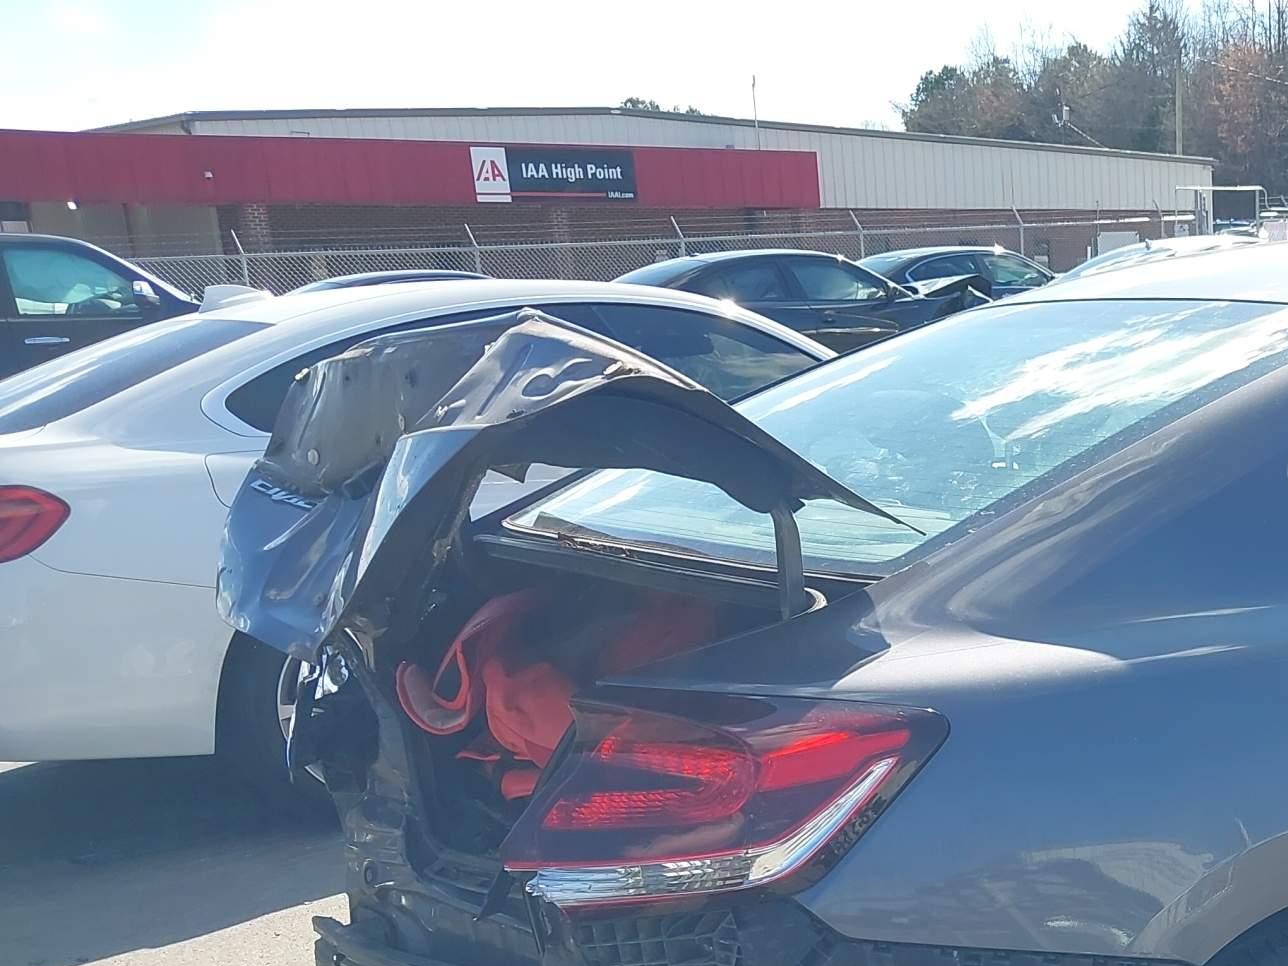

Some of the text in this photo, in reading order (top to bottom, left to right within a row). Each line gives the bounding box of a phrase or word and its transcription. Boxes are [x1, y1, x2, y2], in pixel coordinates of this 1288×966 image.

[521, 162, 623, 182] IAA High Point
[607, 191, 634, 199] IAAI.com
